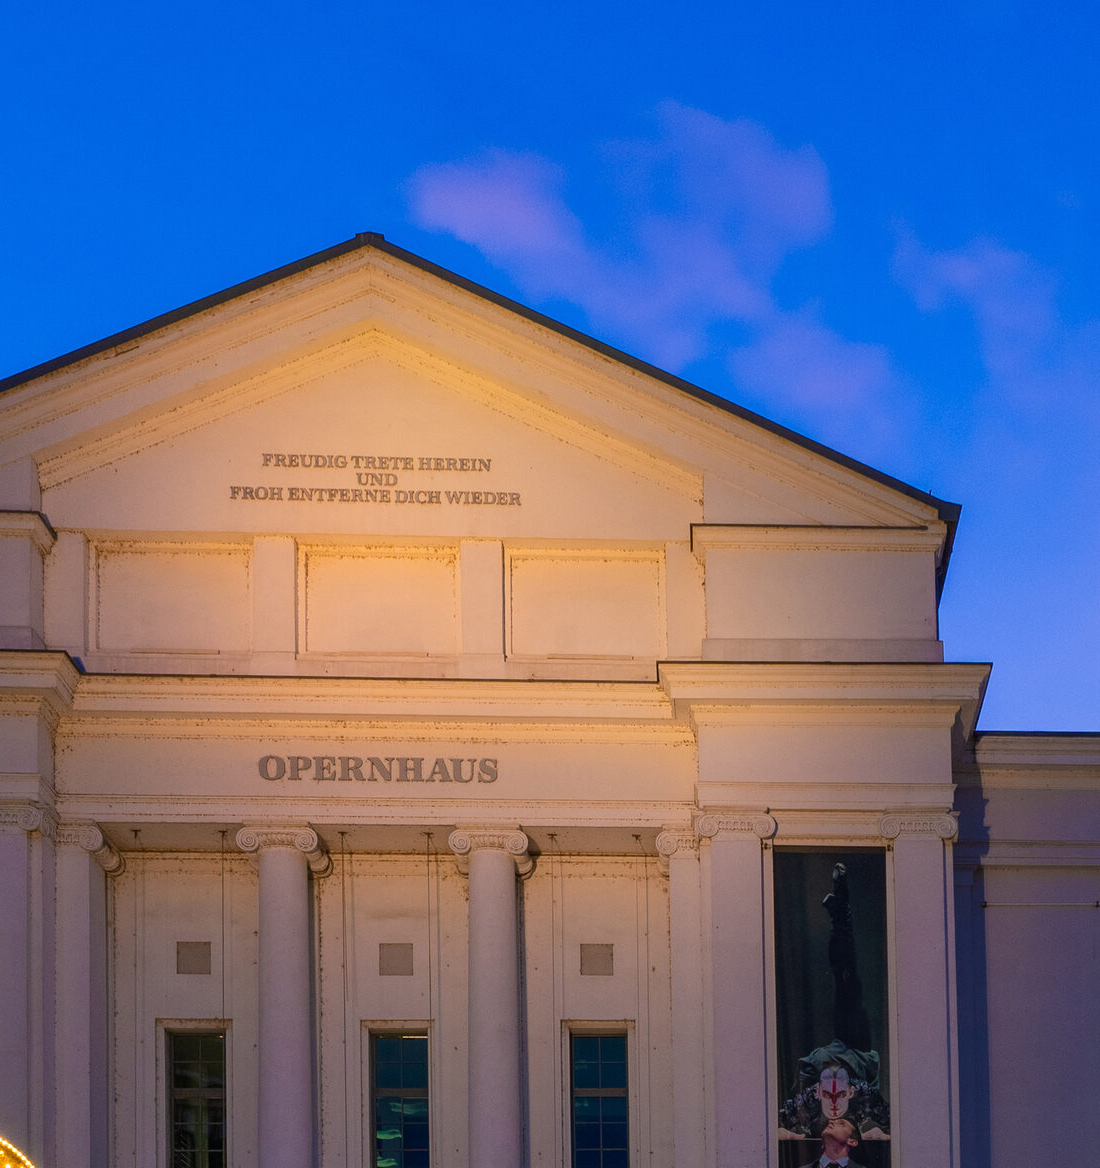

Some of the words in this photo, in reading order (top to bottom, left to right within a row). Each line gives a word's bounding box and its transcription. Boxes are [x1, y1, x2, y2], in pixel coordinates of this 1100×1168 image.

[261, 453, 348, 468] FREUDIG
[350, 455, 414, 470] TRETE
[418, 457, 492, 472] HEREIN
[356, 472, 398, 486] UND
[229, 486, 283, 500] FROH
[288, 487, 391, 503] ENTFERNE
[394, 489, 441, 504] DICH
[444, 490, 521, 506] WIEDER
[258, 755, 498, 783] OPERNHAUS
